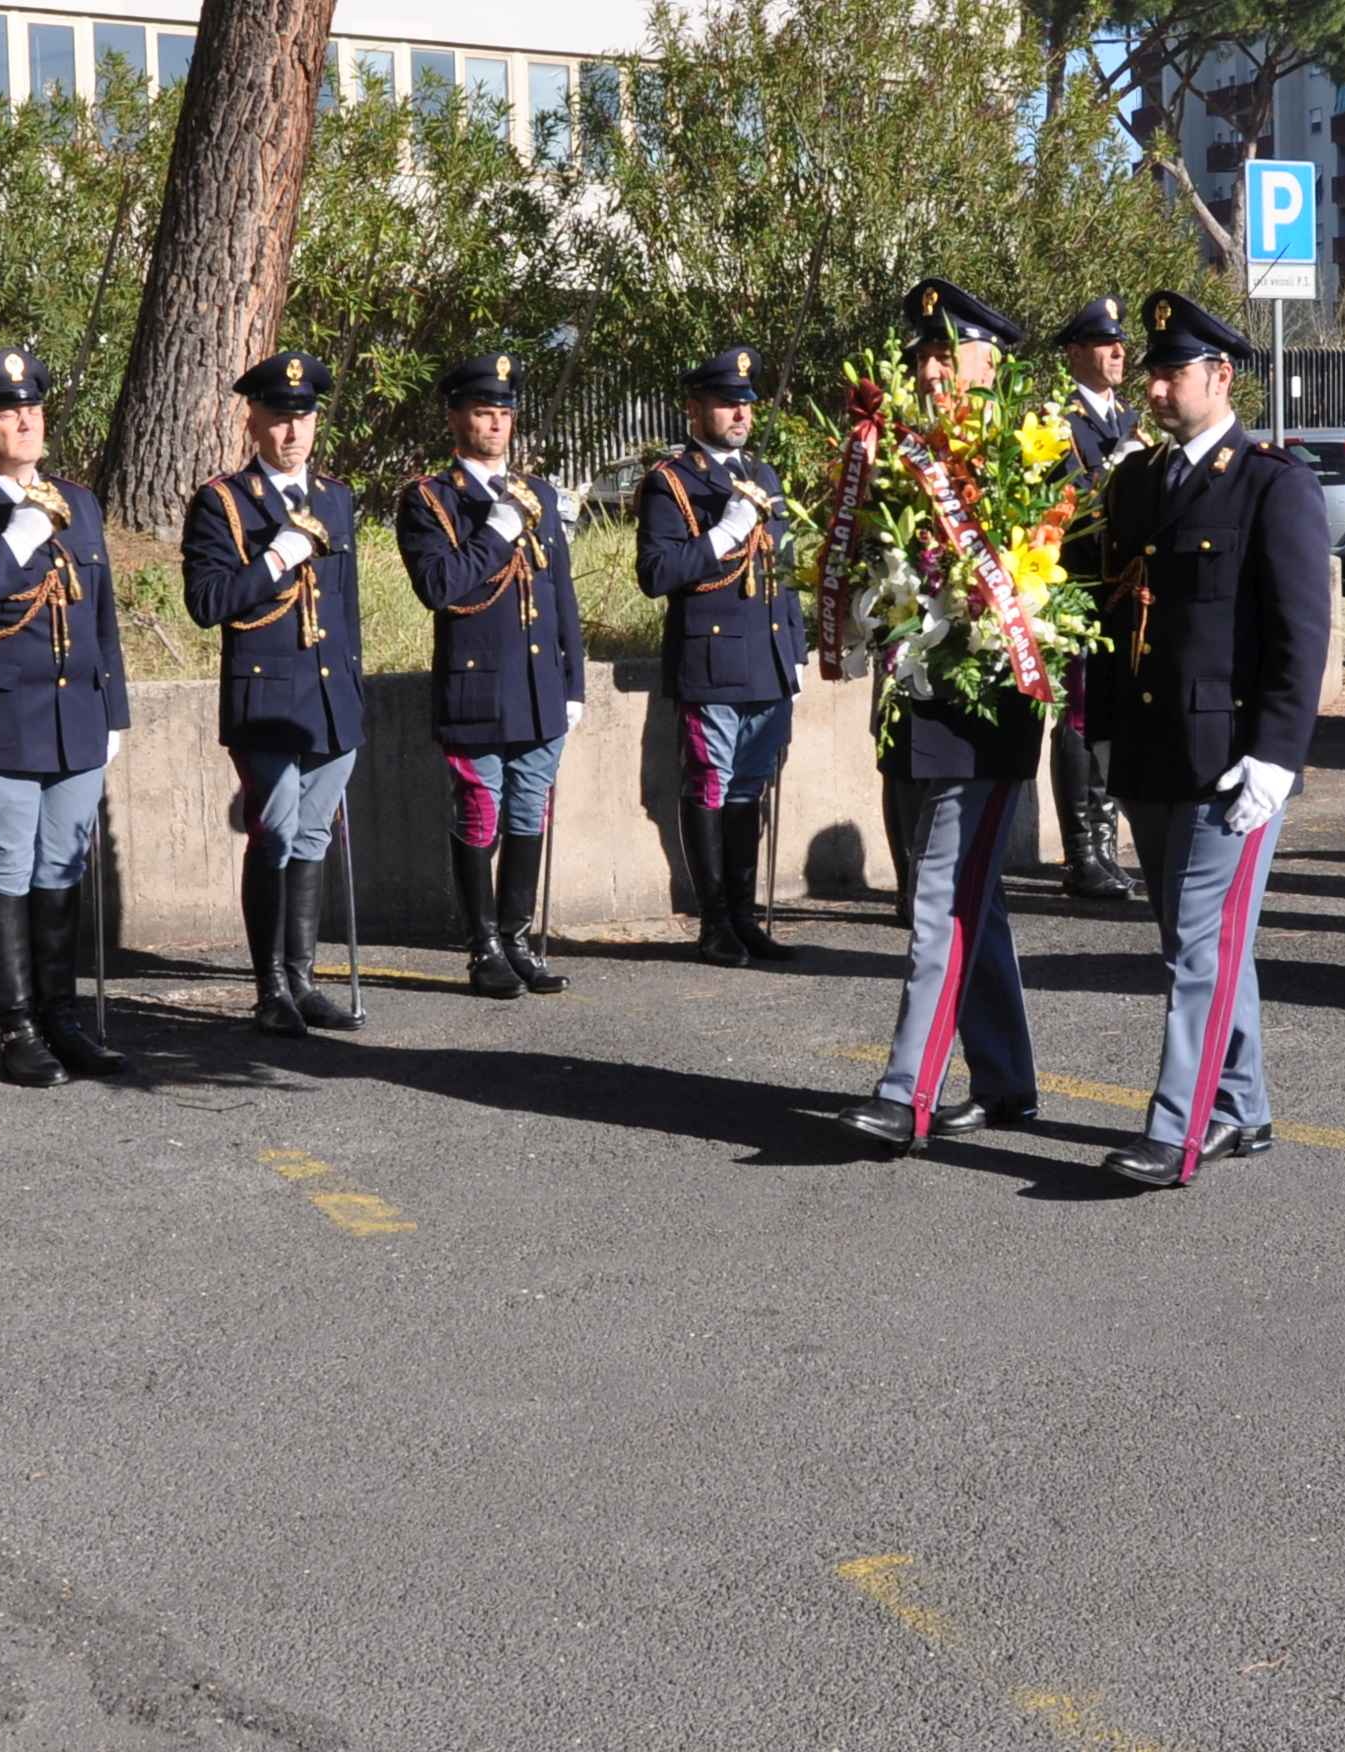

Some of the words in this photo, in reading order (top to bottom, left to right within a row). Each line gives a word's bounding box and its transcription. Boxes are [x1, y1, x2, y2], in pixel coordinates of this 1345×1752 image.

[1261, 170, 1304, 252] P
[822, 599, 838, 643] CAPO
[837, 441, 867, 524] POLIZIA
